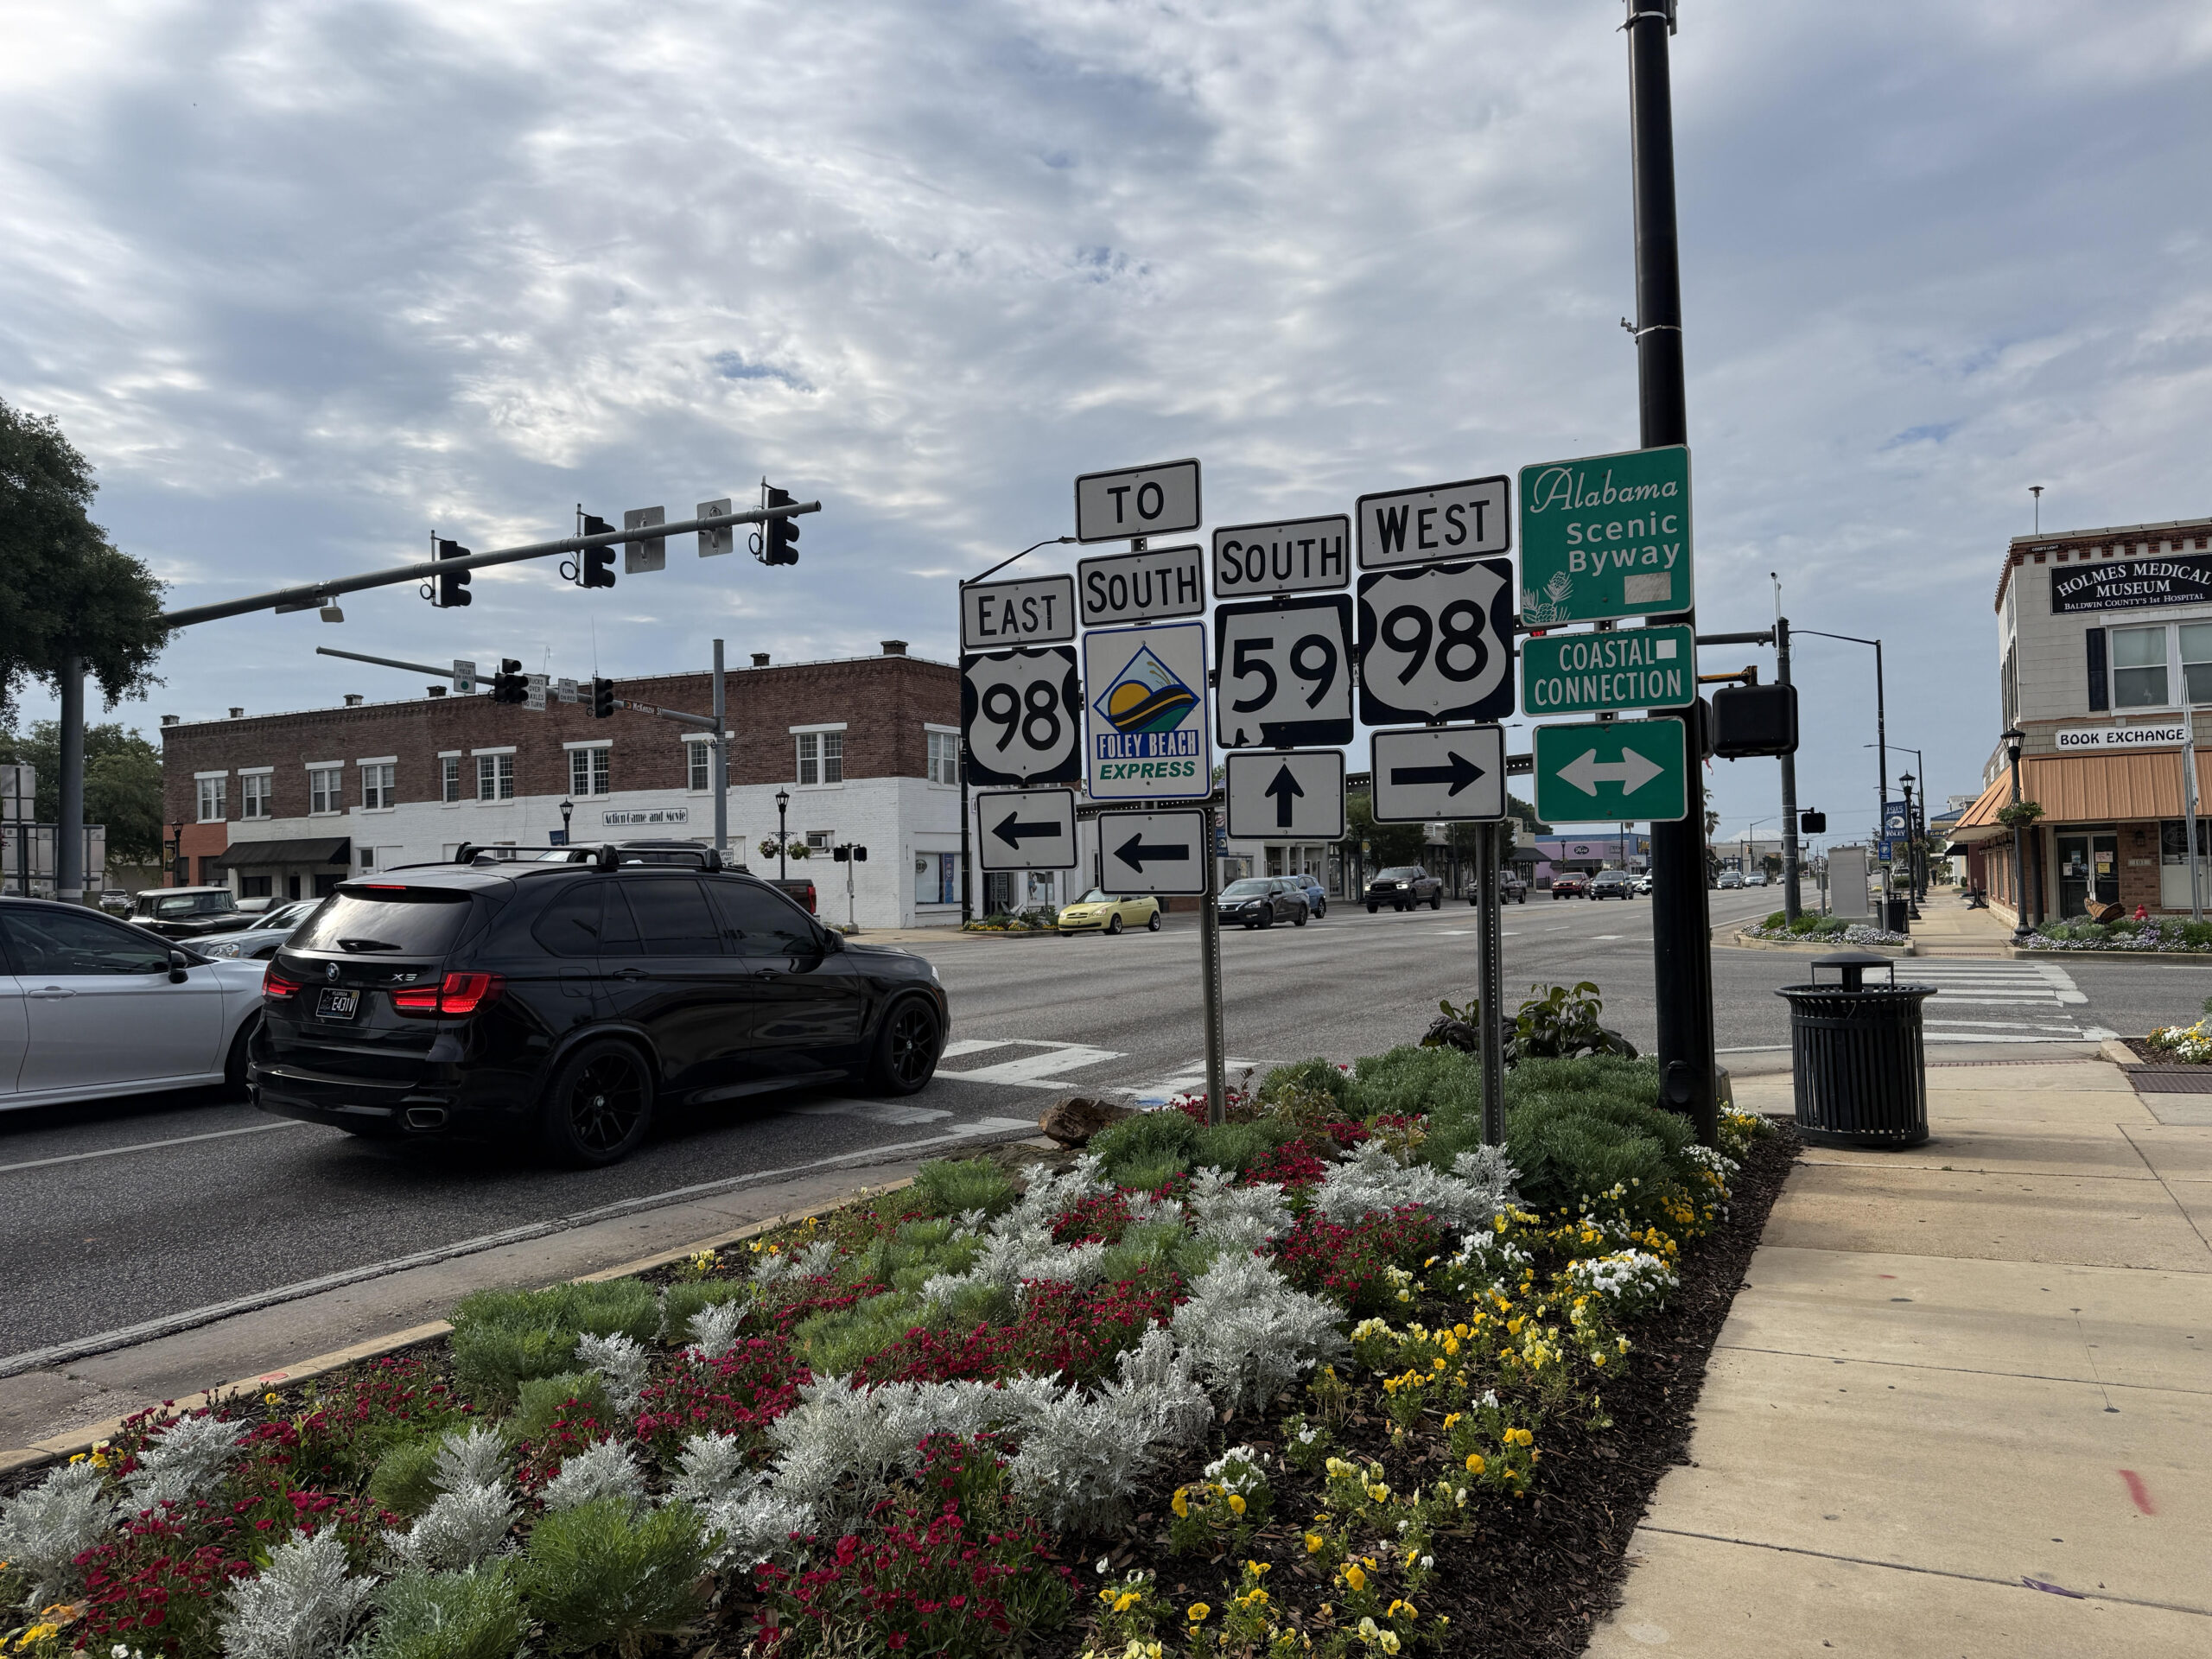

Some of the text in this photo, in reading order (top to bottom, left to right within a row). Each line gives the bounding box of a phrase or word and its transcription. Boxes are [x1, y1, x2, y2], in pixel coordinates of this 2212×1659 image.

[1107, 481, 1165, 524] TO
[1529, 467, 1678, 514] Alabama
[1376, 499, 1491, 554] WEST
[1567, 512, 1678, 545] Scenic
[1221, 537, 1342, 584] SOUTH
[1570, 543, 1681, 576] Byway
[1087, 565, 1198, 614] SOUTH
[2056, 563, 2212, 597] HOLMES MEDICAL
[2095, 580, 2171, 598] MUSEUM
[978, 594, 1057, 638] EAST
[2064, 601, 2102, 610] BALDWIN
[2105, 597, 2147, 607] COUNTY'S
[2164, 594, 2205, 602] HOSPITAL
[1381, 599, 1503, 686] 98
[1559, 639, 1655, 671] COASTAL
[1231, 633, 1338, 714] 59
[1535, 670, 1681, 706] CONNECTION
[632, 702, 655, 715] McKenzie
[982, 680, 1061, 753] 98
[1099, 730, 1199, 759] FOLEY BEACH
[2060, 728, 2184, 746] BOOK EXCHANGE
[1099, 760, 1195, 781] EXPRESS
[606, 810, 685, 825] Action Game and Movie
[332, 996, 355, 1012] E431V
